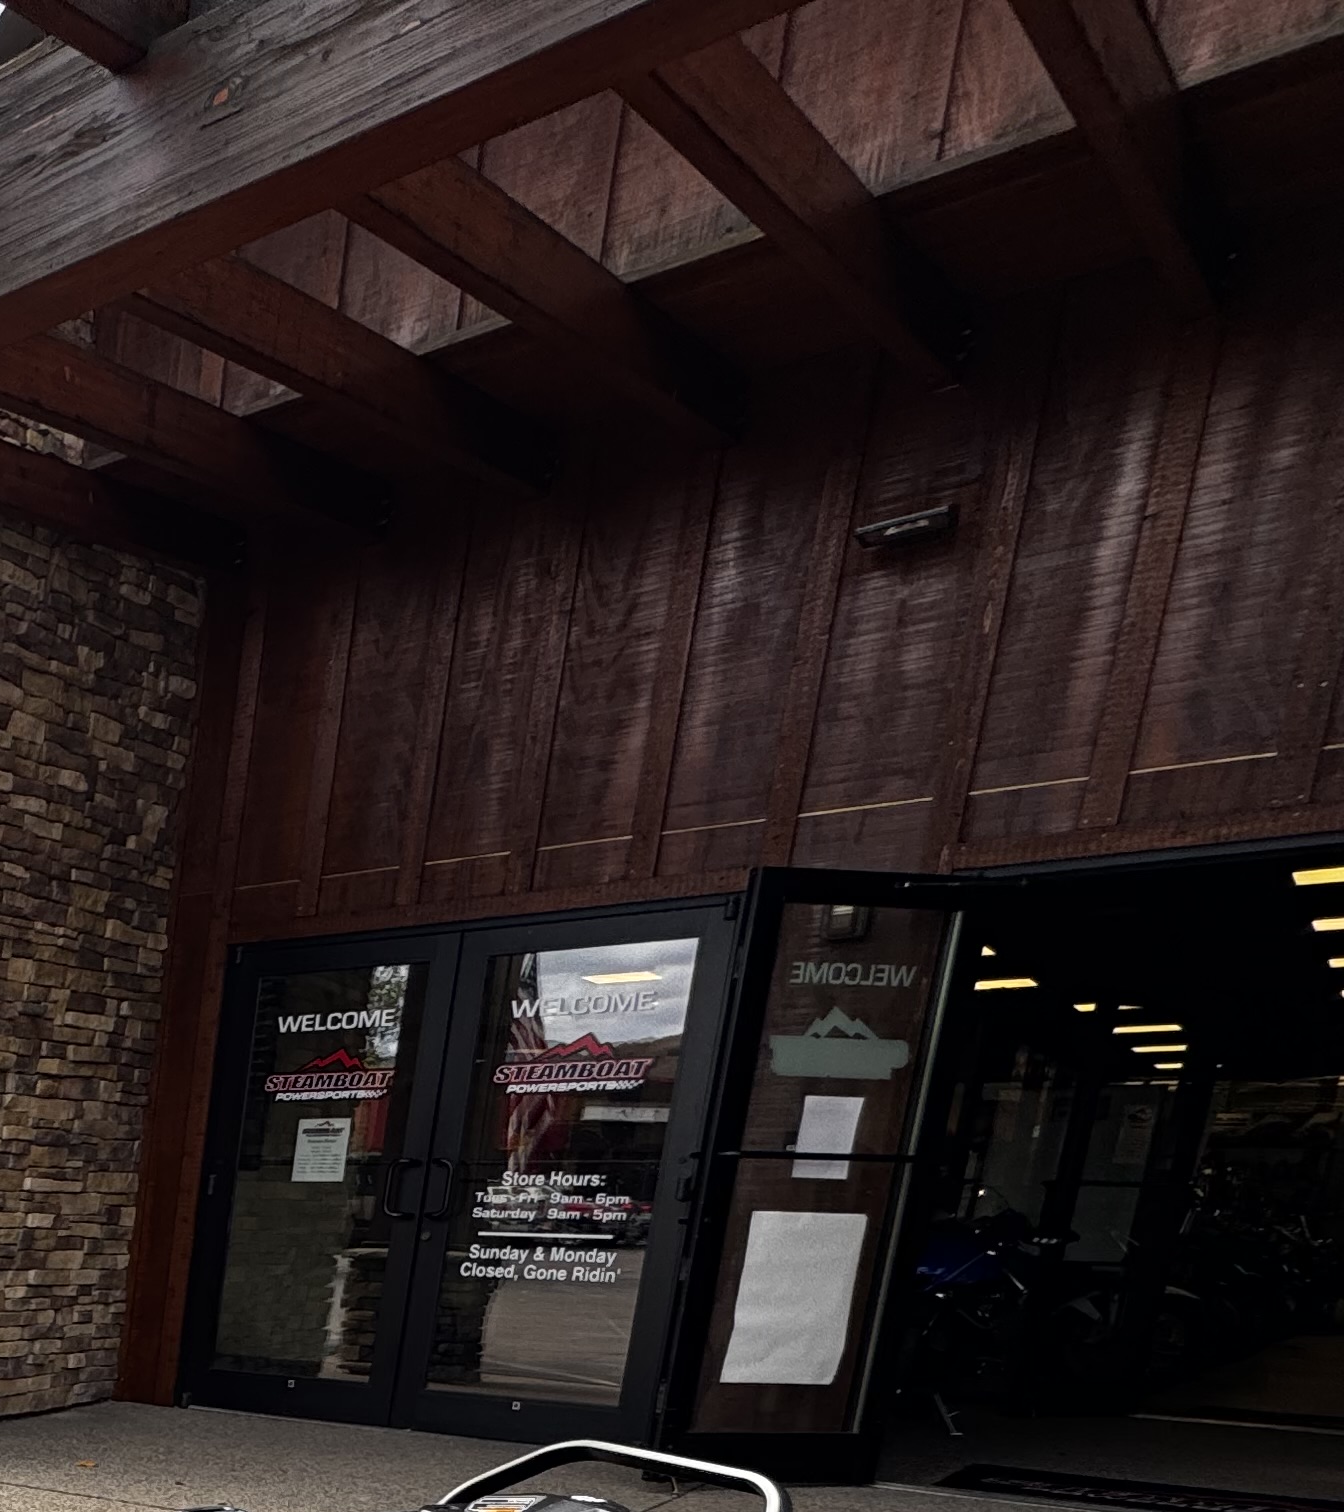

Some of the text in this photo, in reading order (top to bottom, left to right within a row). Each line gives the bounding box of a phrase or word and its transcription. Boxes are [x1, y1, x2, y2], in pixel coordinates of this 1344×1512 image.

[512, 990, 658, 1019] WELCOME
[278, 1009, 397, 1033] WELCOME
[265, 1070, 395, 1091] STEAMBOAT
[493, 1058, 655, 1083] STEAMBOAT
[275, 1090, 369, 1101] POWERSPORTS
[506, 1081, 617, 1095] POWERSPORTS
[501, 1170, 606, 1187] Store Hours:
[550, 1192, 583, 1204] 9am
[472, 1207, 537, 1222] Saturday
[547, 1208, 580, 1220] 9am
[592, 1209, 628, 1223] 5pm
[469, 1244, 618, 1268] Sunday & Monday
[460, 1262, 622, 1283] Closed, Gone Ridin'
